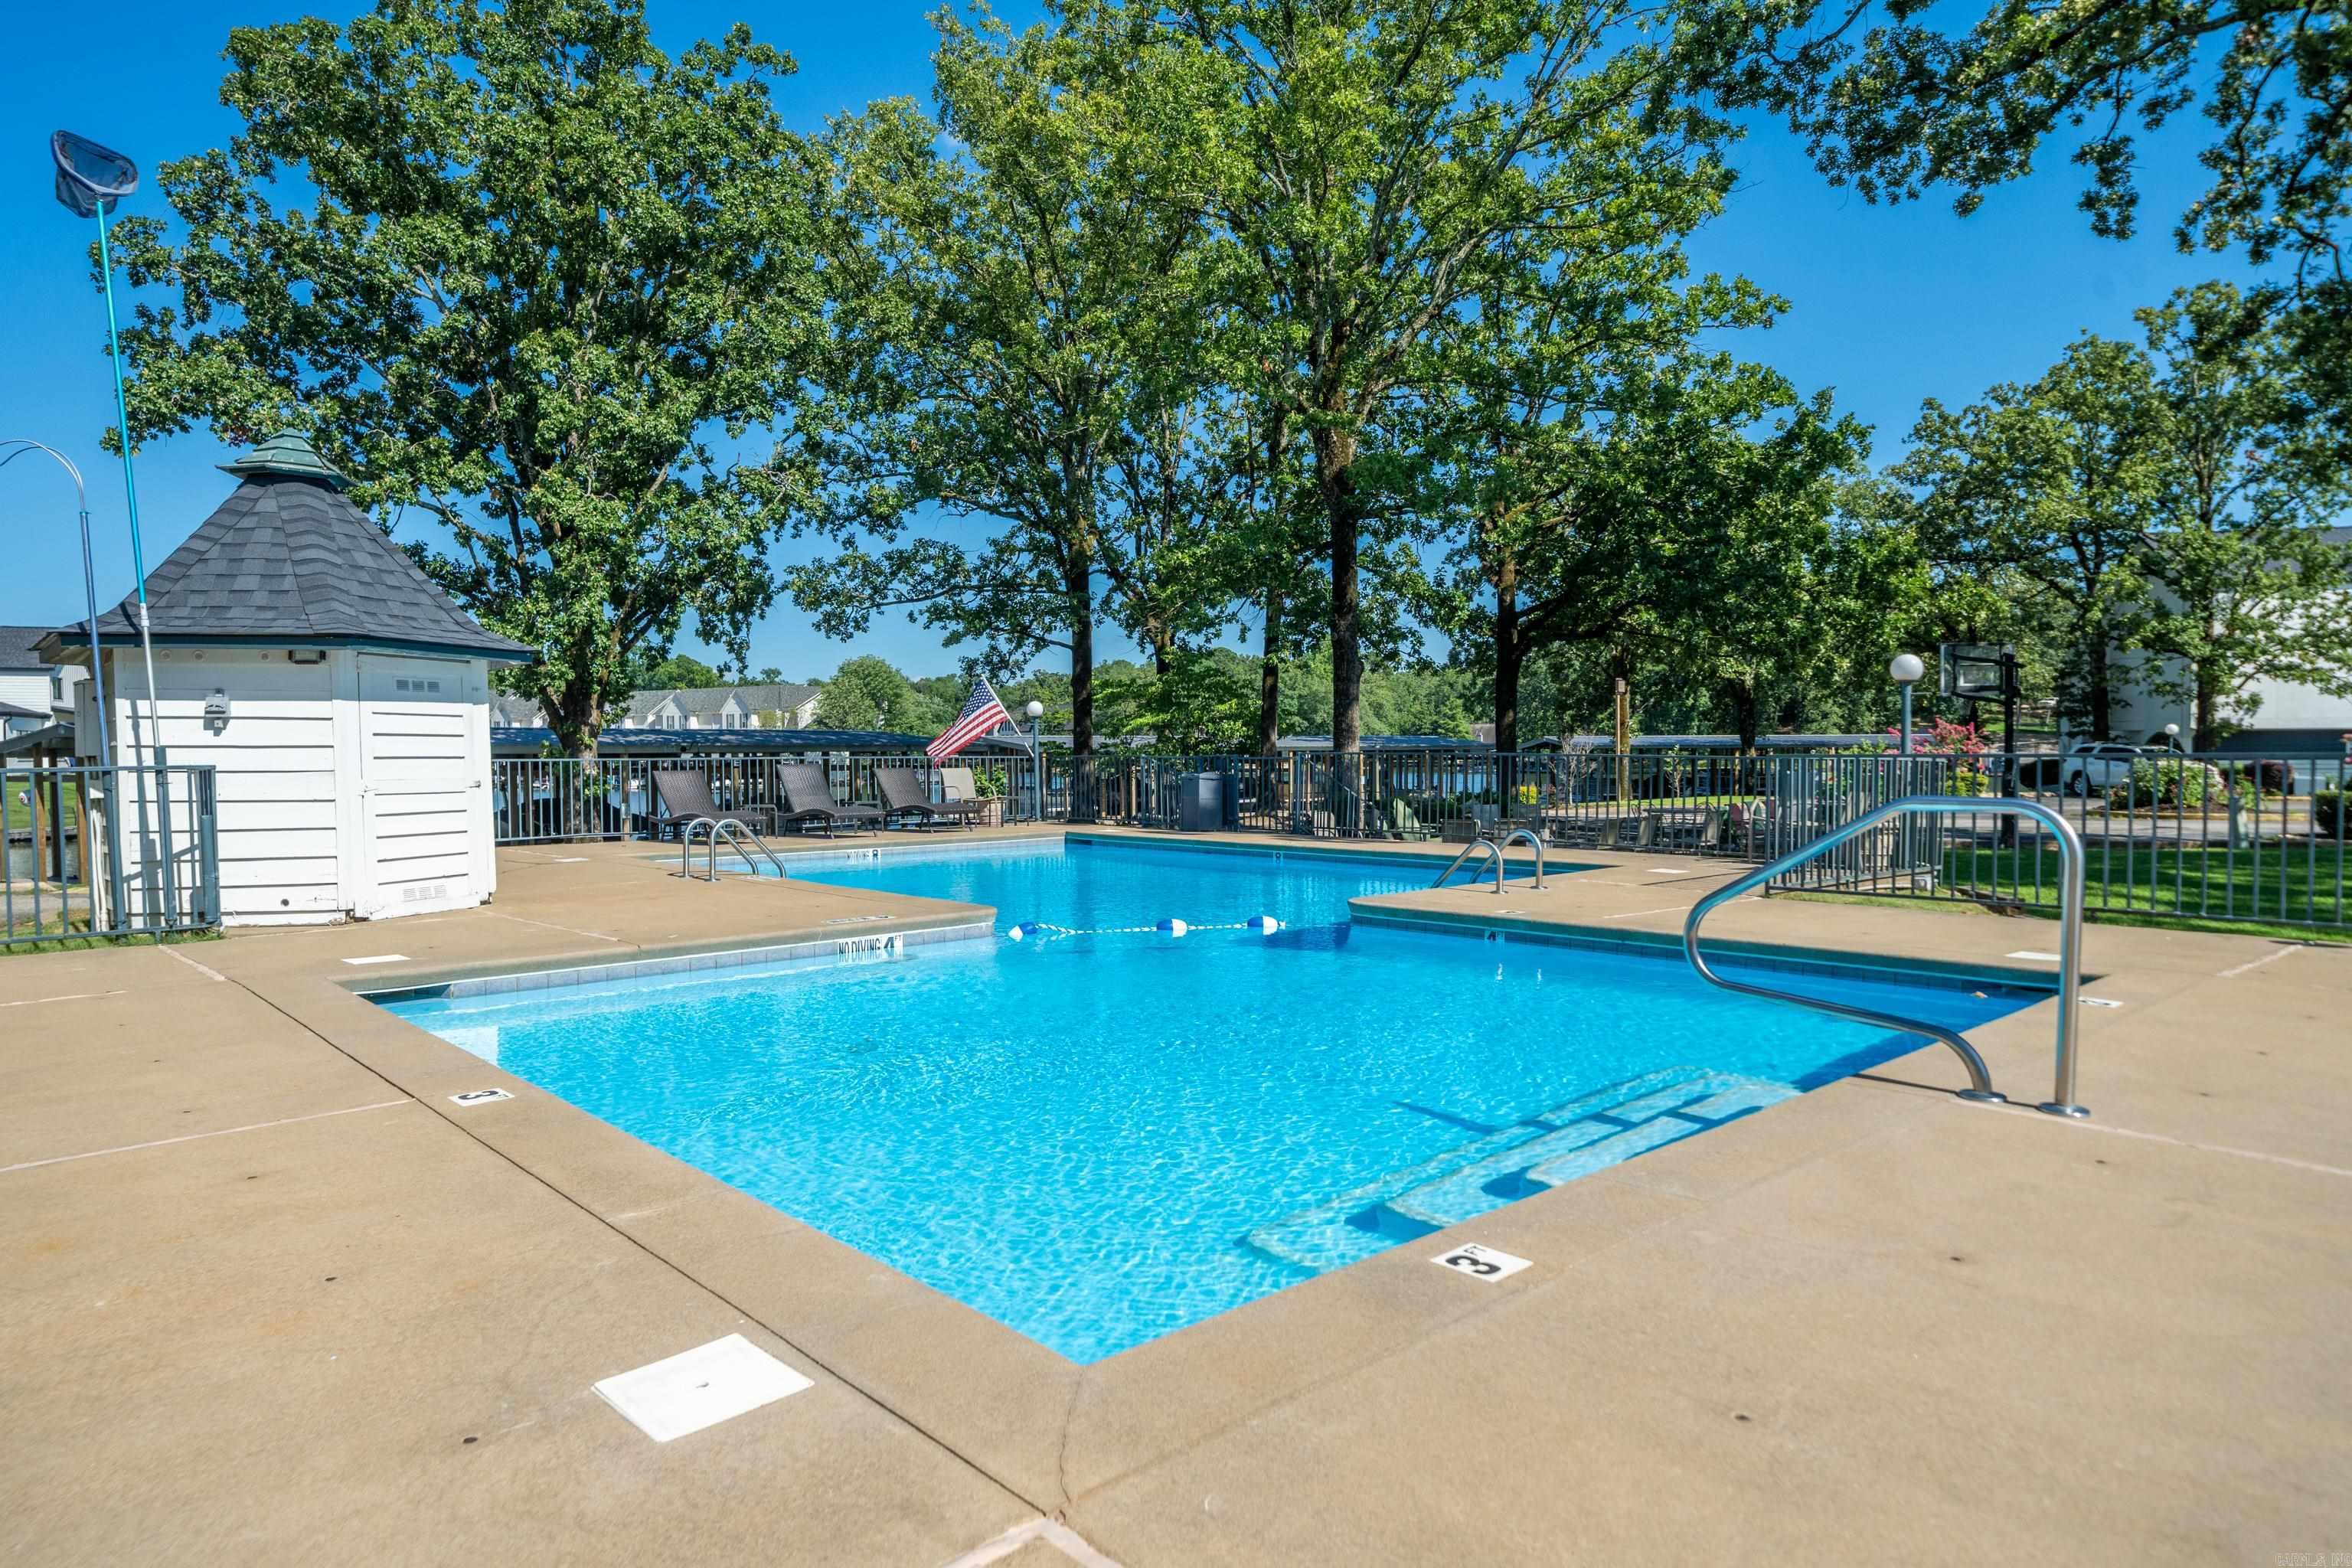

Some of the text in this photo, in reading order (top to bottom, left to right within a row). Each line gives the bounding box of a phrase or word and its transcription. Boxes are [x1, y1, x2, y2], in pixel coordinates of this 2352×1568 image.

[838, 942, 850, 955] NO
[851, 938, 880, 953] DIVING
[883, 936, 894, 949] 4
[1445, 1255, 1501, 1275] 3
